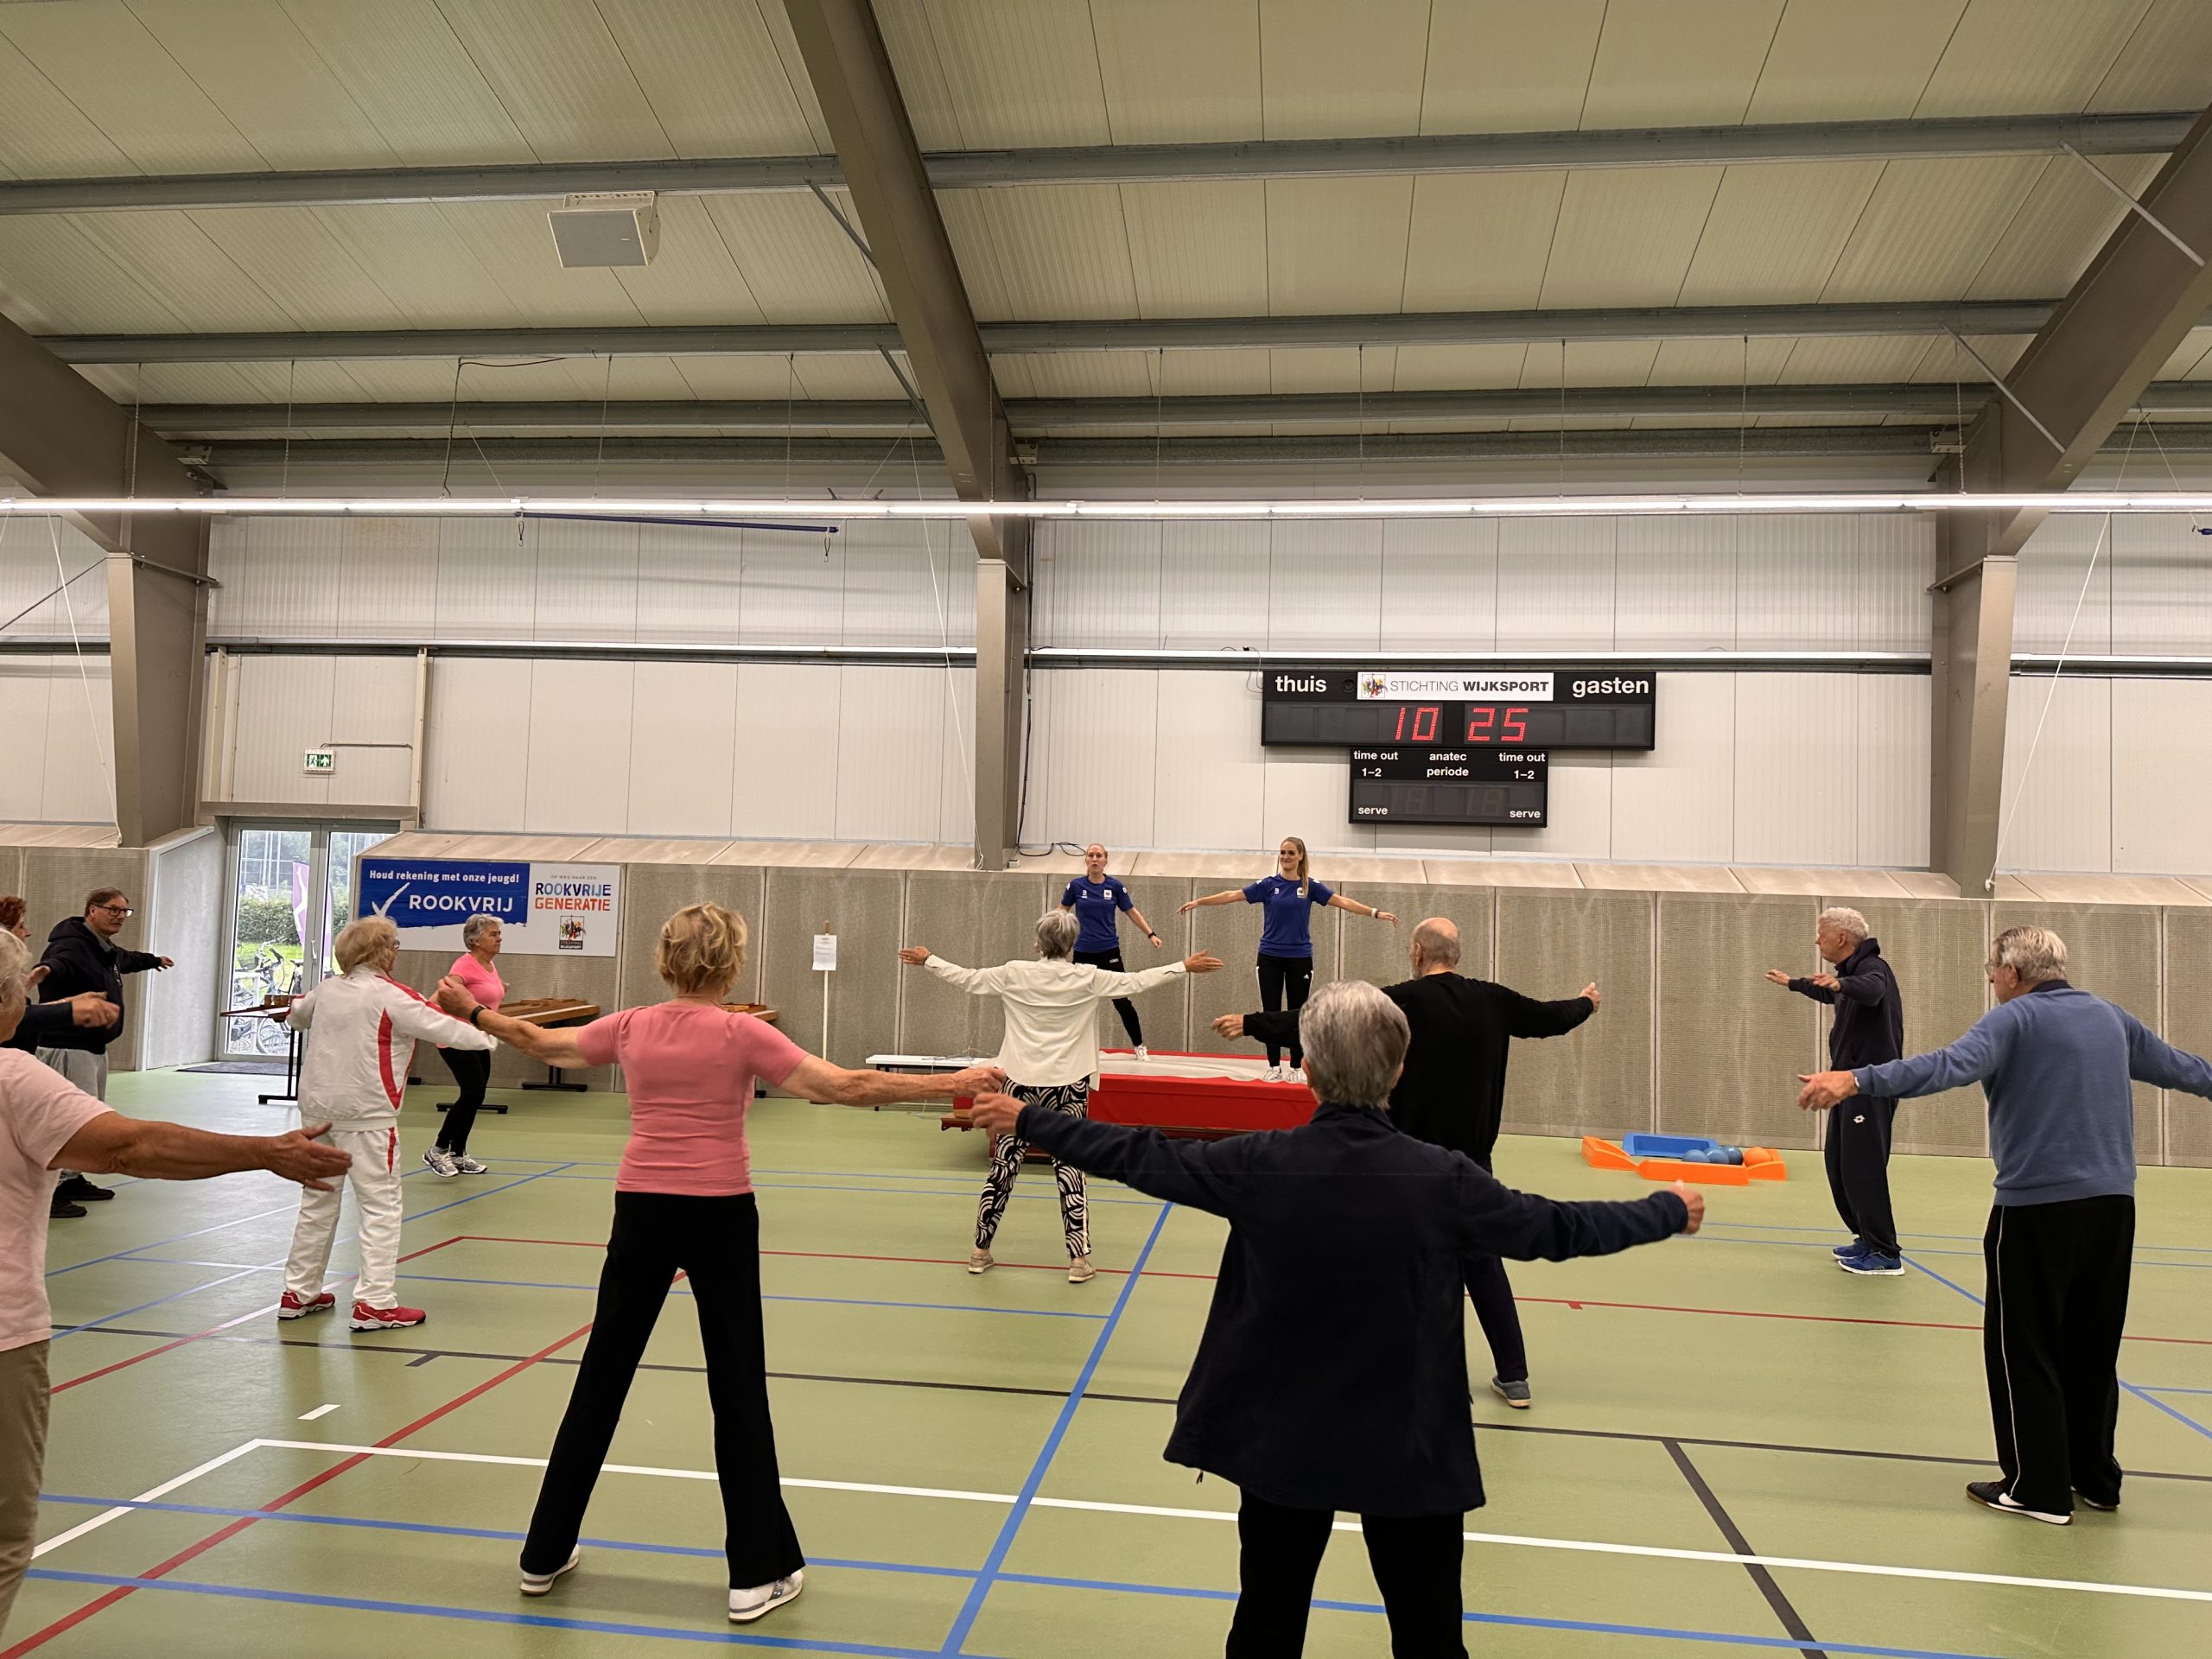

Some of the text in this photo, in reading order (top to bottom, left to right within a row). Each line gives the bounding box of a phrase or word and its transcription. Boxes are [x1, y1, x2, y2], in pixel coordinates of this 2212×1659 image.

[1274, 675, 1327, 693] thuis
[1389, 680, 1549, 692] STICHTING WIJKSPORT
[1572, 677, 1649, 698] gasten
[1395, 707, 1529, 741] 10 25
[1353, 750, 1399, 760] time out
[1429, 752, 1467, 761] anatec
[1498, 752, 1546, 762] time out
[1427, 766, 1469, 778] periode
[369, 869, 394, 880] Houd
[396, 871, 440, 883] rekening
[442, 873, 461, 881] met
[487, 873, 519, 885] jeugd!
[535, 882, 612, 897] ROOKVRIJE
[409, 894, 513, 912] ROOKVRIJ
[534, 897, 611, 912] GENERATIE
